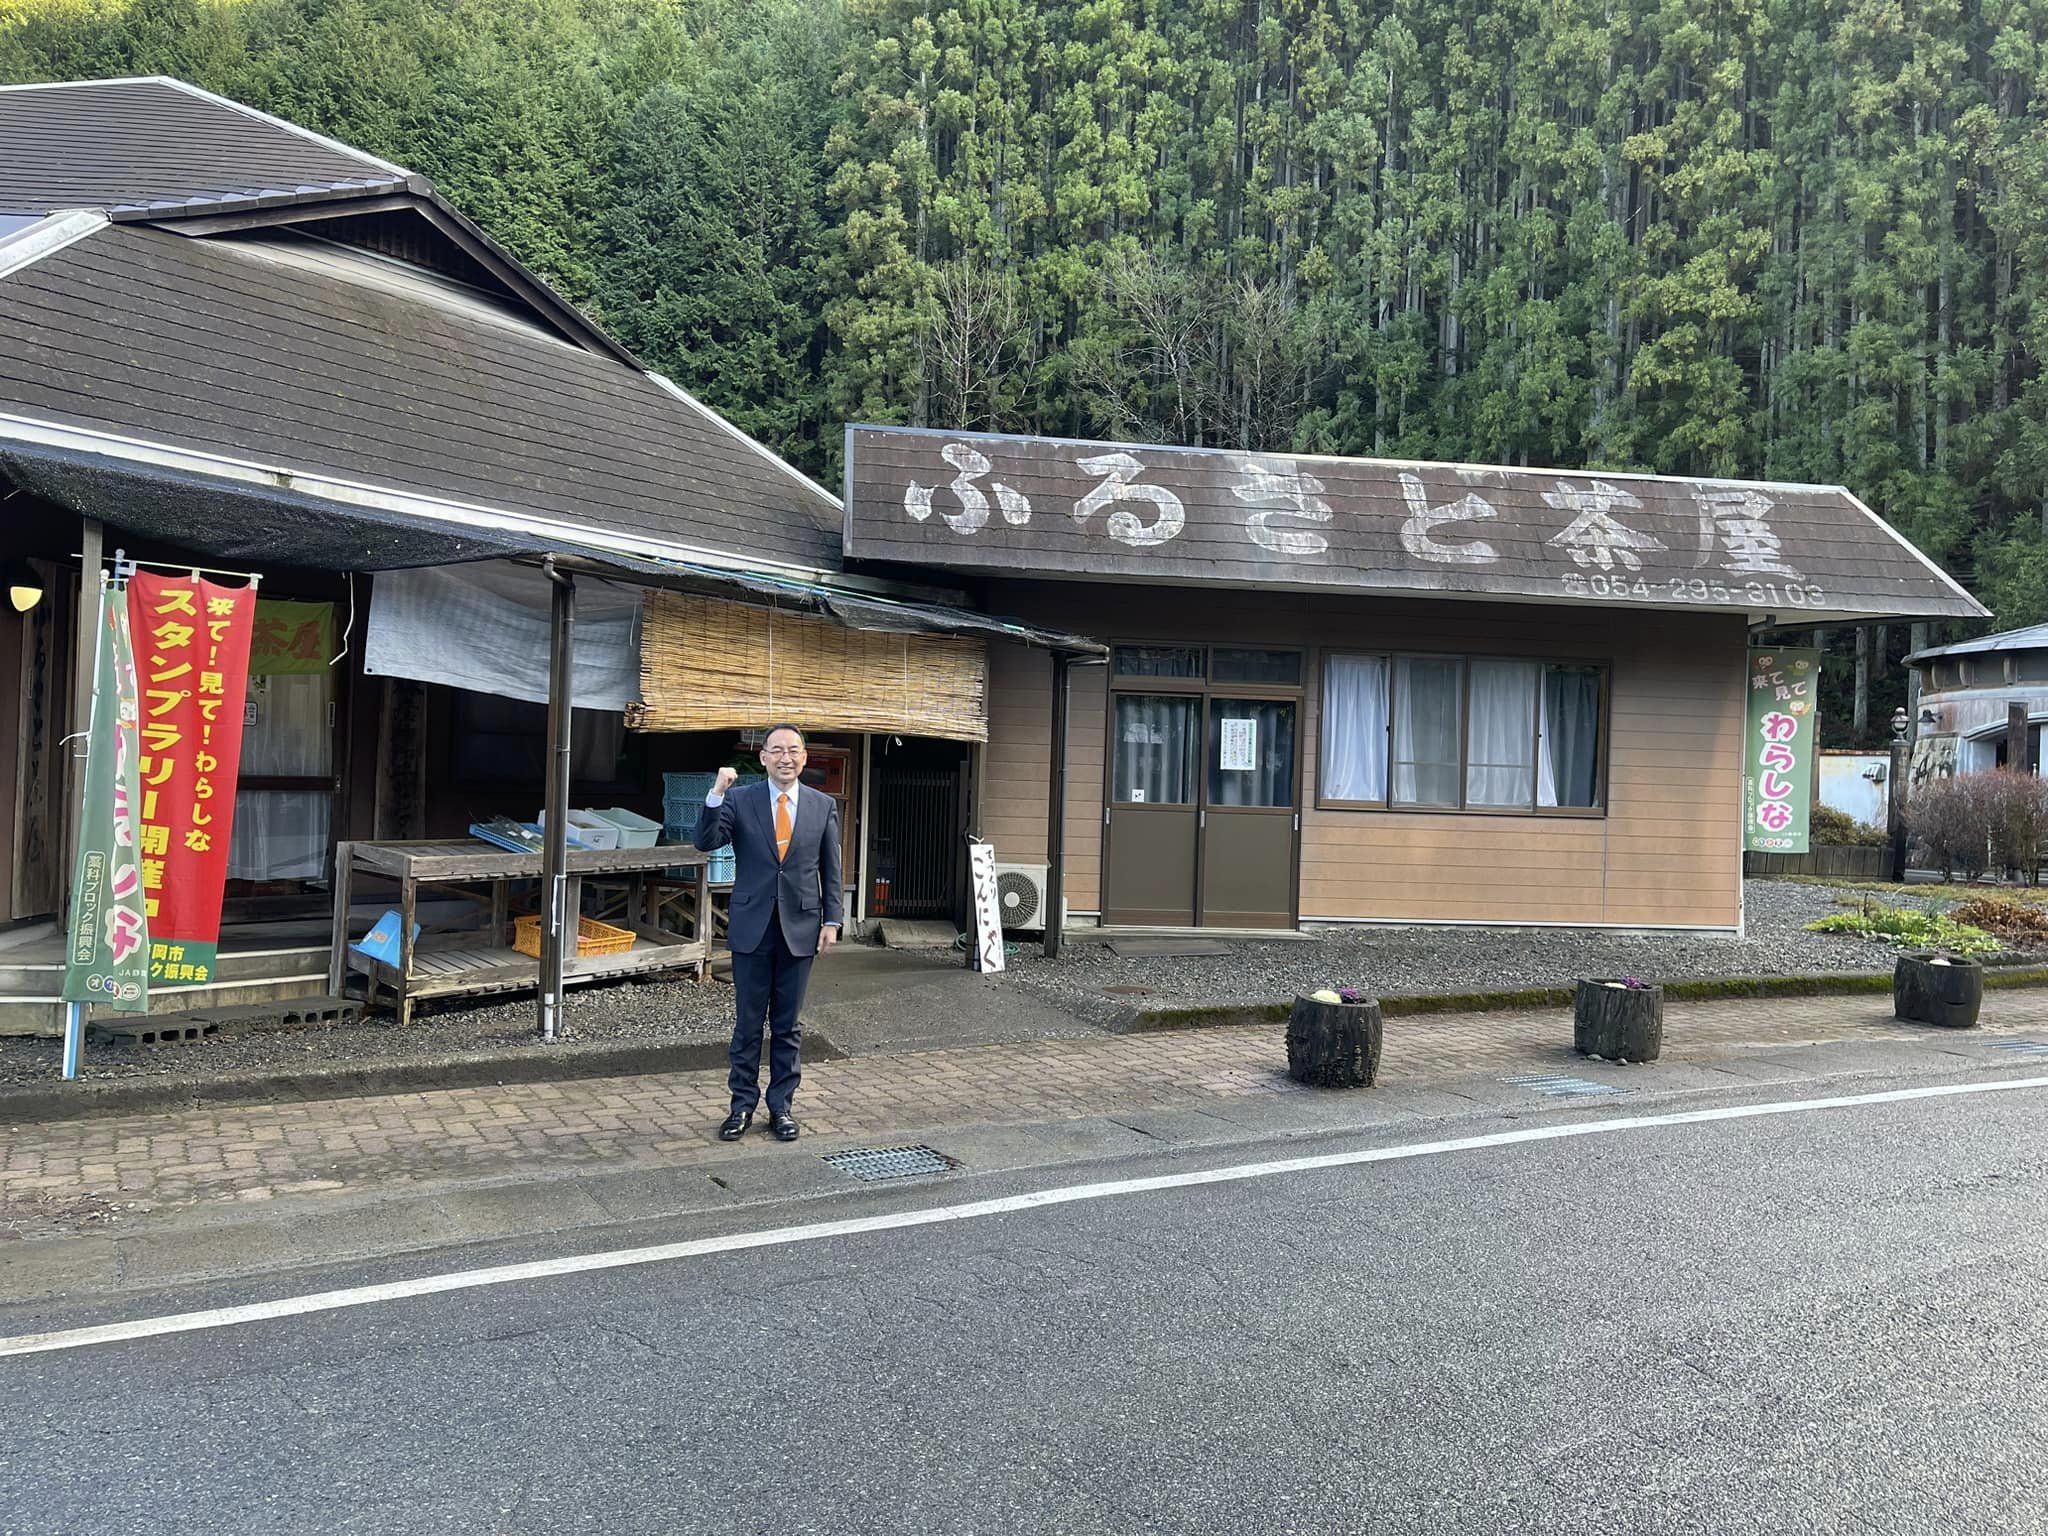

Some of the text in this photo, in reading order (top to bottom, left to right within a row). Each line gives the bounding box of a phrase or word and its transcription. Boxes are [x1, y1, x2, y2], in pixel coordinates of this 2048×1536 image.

[903, 442, 1805, 581] ふるさと茶屋
[184, 596, 235, 851] 来て！見て！わらしな
[1759, 712, 1797, 831] わらしな
[148, 943, 185, 961] 岡市
[973, 857, 997, 969] こんにゃく
